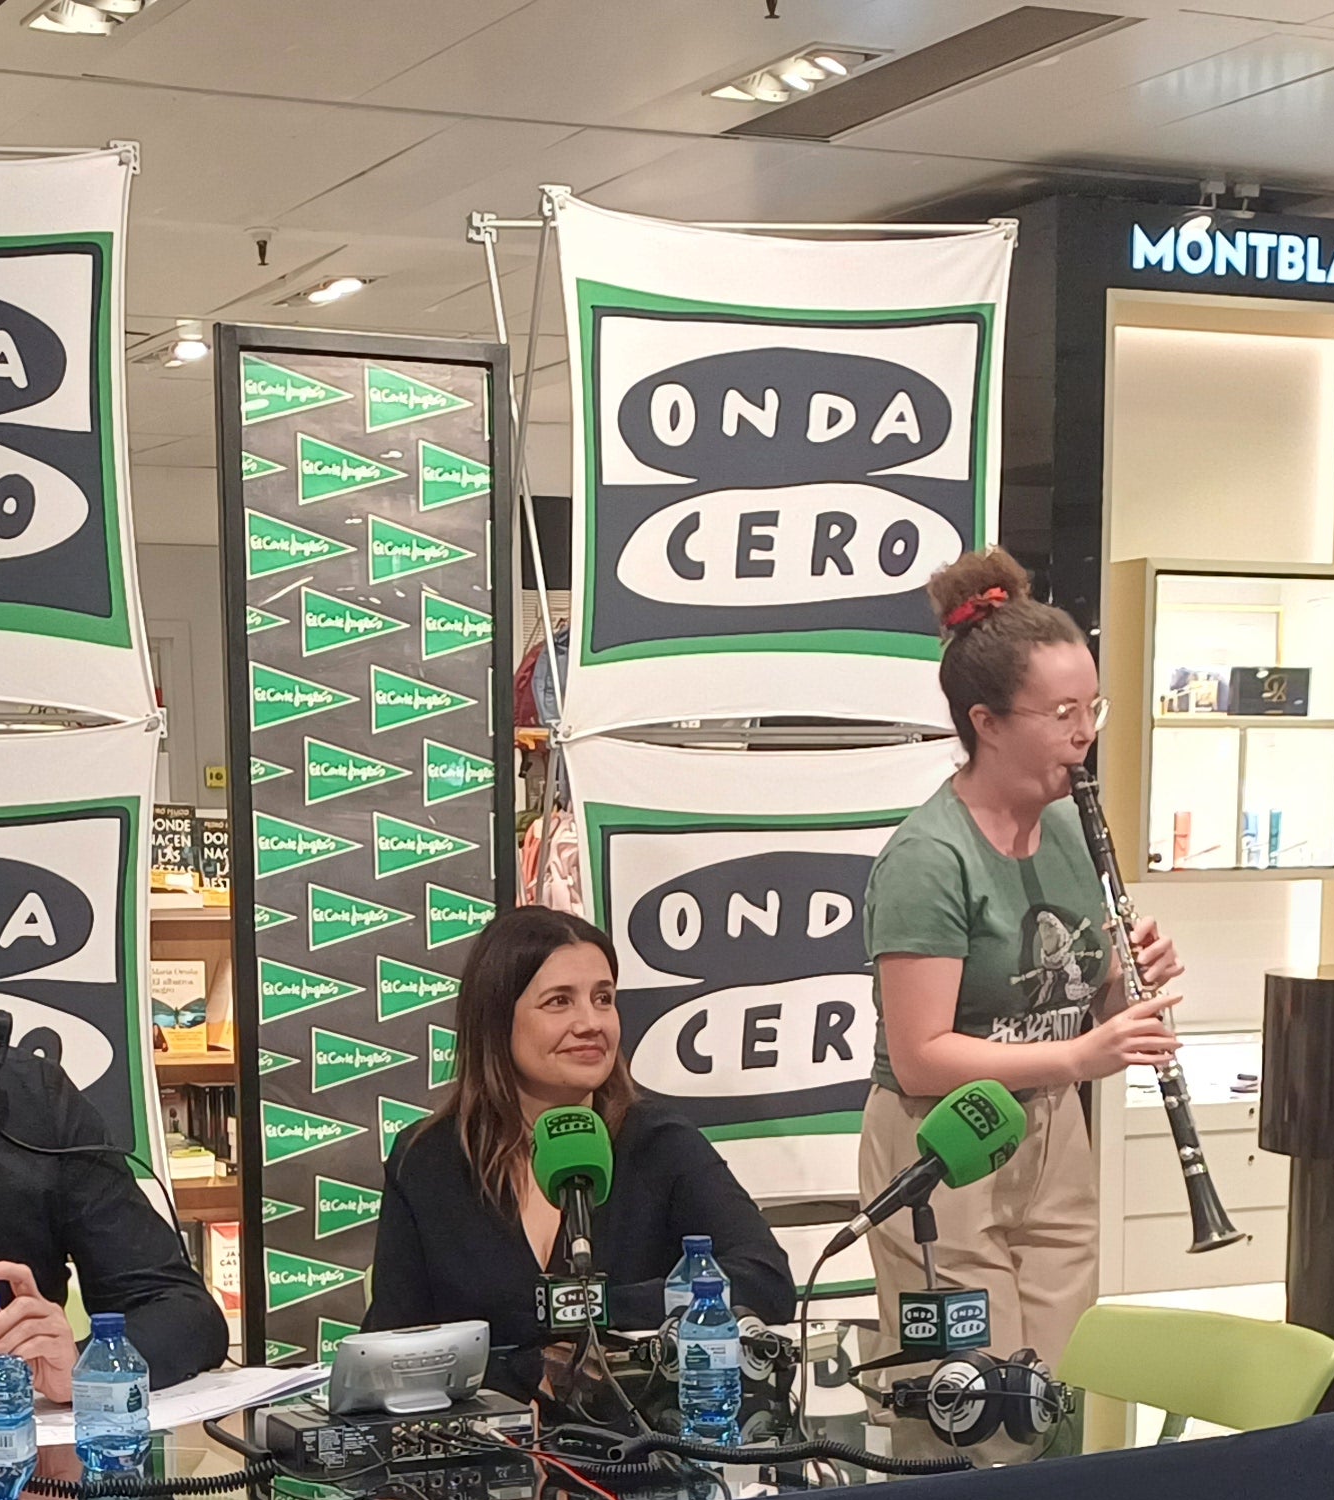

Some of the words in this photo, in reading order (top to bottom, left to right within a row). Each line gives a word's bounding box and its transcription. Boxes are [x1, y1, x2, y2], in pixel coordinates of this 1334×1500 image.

[650, 381, 922, 447] ONDA
[666, 509, 921, 581] CERO
[154, 818, 192, 832] ONDE
[658, 889, 854, 951] OND
[675, 1001, 857, 1075] CER
